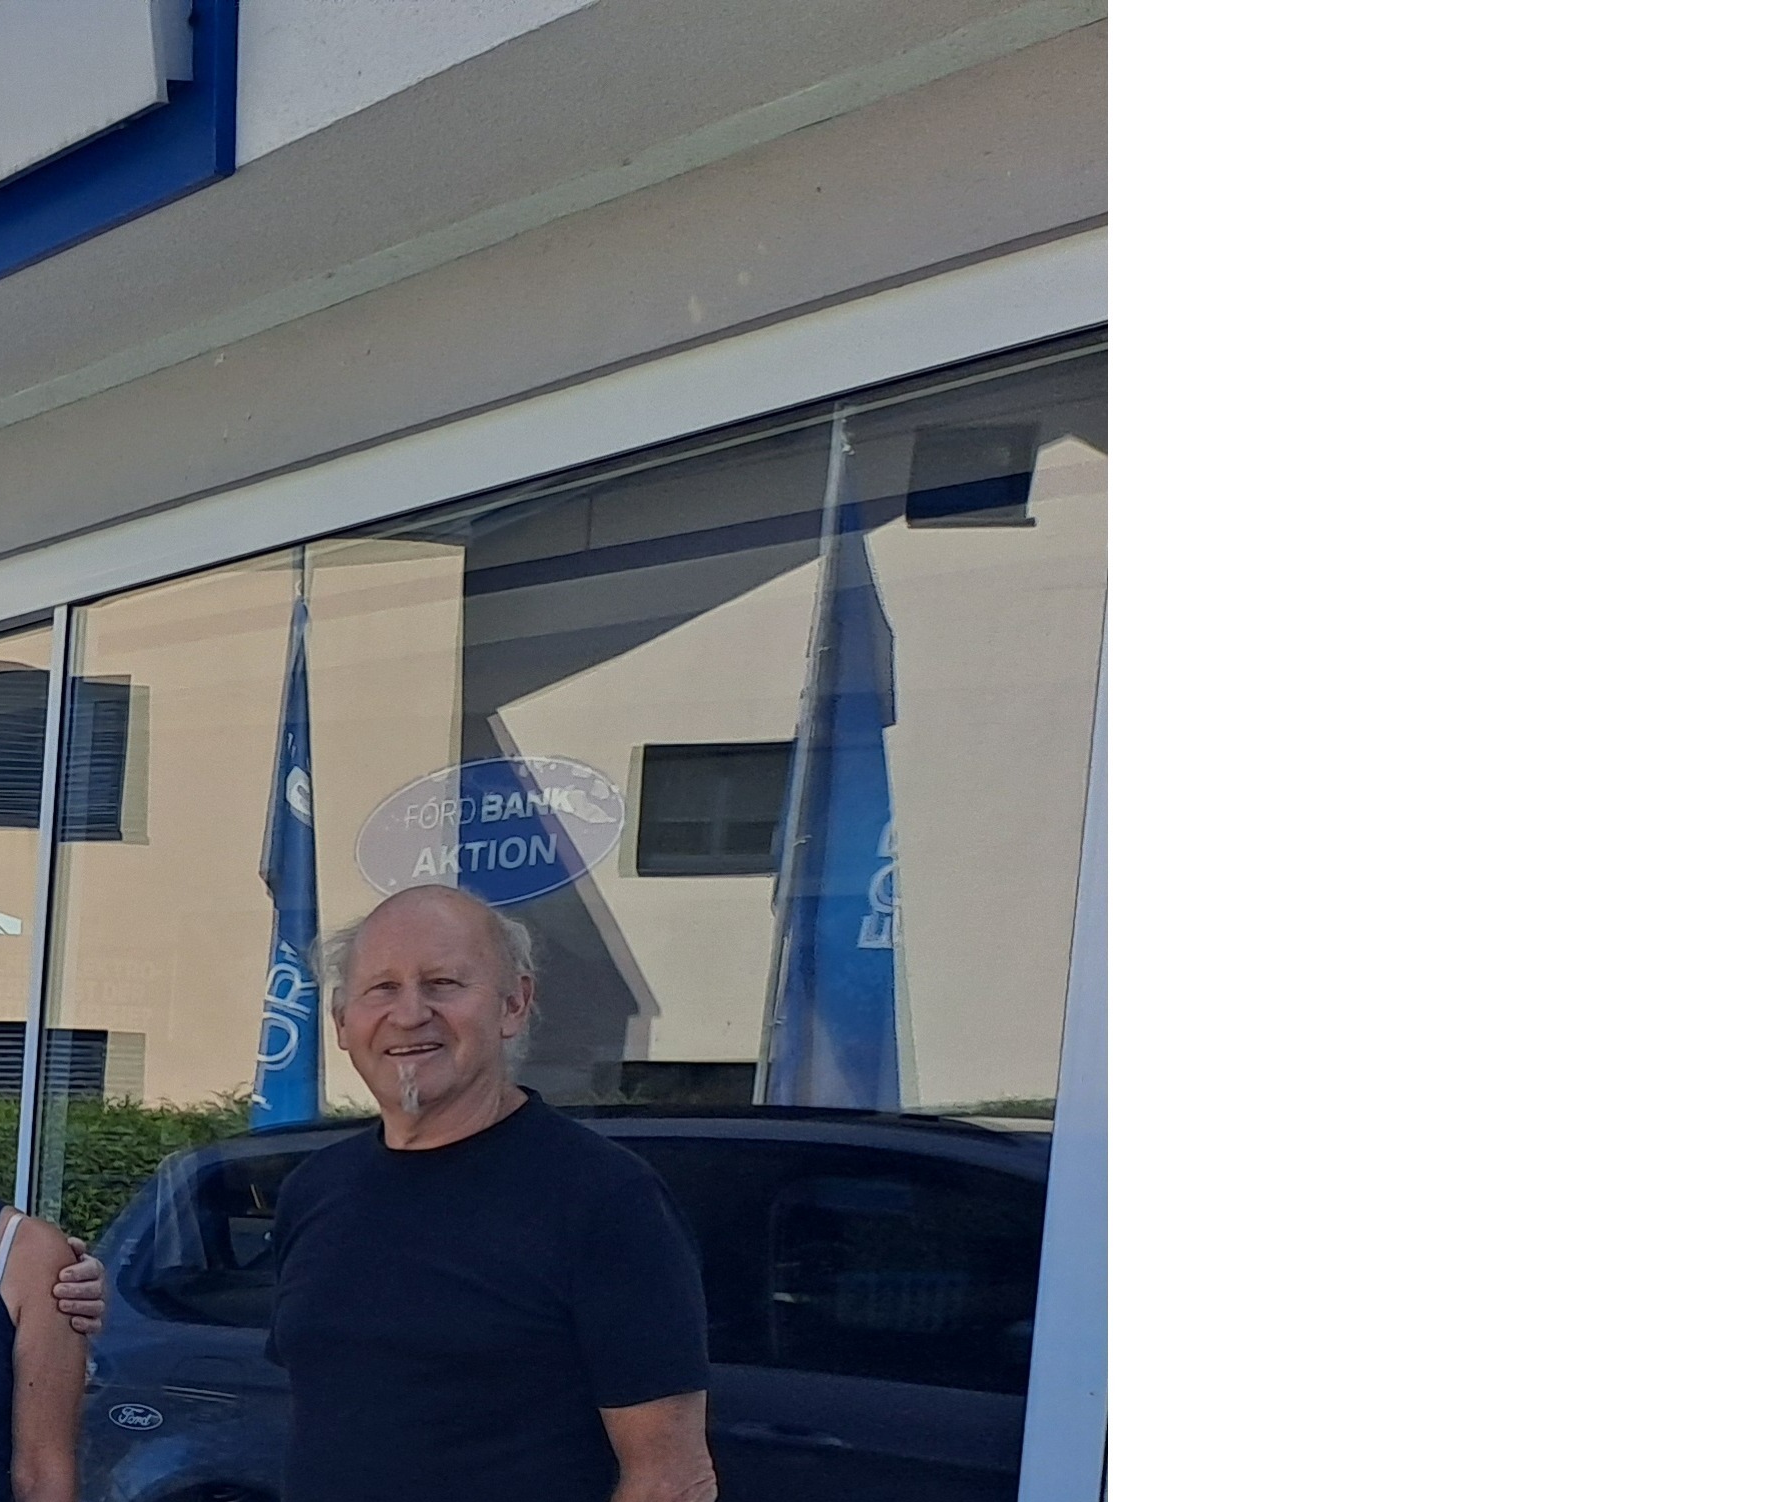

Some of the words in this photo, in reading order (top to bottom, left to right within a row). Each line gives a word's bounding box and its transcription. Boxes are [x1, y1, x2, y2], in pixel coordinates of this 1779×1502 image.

[404, 796, 477, 831] FORD
[481, 786, 576, 824] BANK
[412, 832, 558, 879] AKTION
[118, 1406, 151, 1426] Ford
